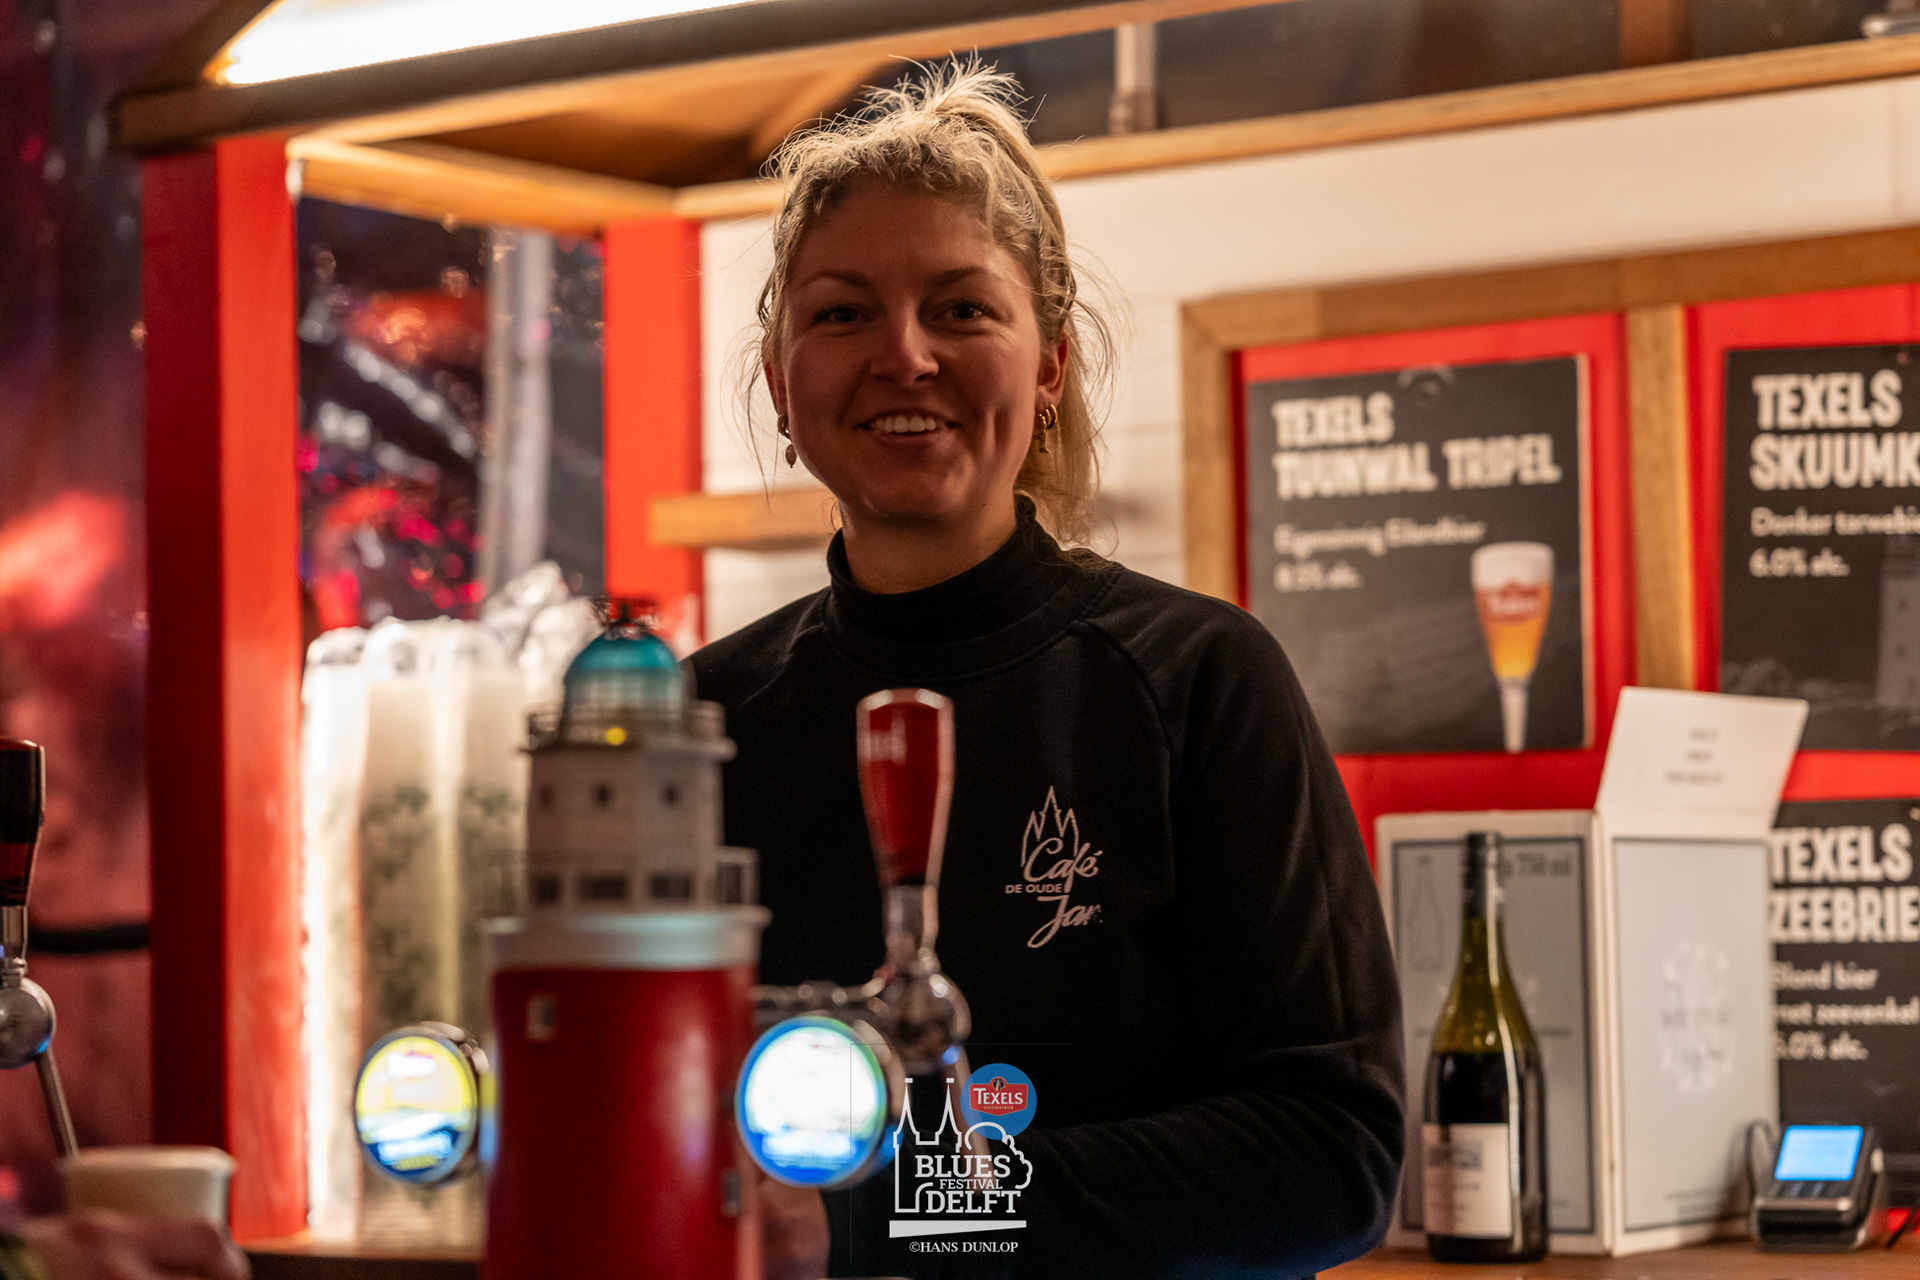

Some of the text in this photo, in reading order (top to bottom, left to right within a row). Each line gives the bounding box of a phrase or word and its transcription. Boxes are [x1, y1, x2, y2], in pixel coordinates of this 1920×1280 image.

[1272, 392, 1395, 448] TEXELS
[1752, 369, 1902, 431] TEXELS
[1273, 433, 1562, 499] TUUNWAL TRIPEL
[1749, 432, 1920, 490] SKUUMK
[1751, 506, 1832, 537] Donker
[1749, 547, 1849, 577] 6.0% alc.
[1023, 837, 1103, 893] Café
[1772, 823, 1913, 882] TEXELS
[1005, 883, 1063, 894] DE OUDE
[1834, 960, 1878, 990] bier
[1816, 995, 1920, 1025] zeevenkel
[1829, 1030, 1868, 1061] alc.
